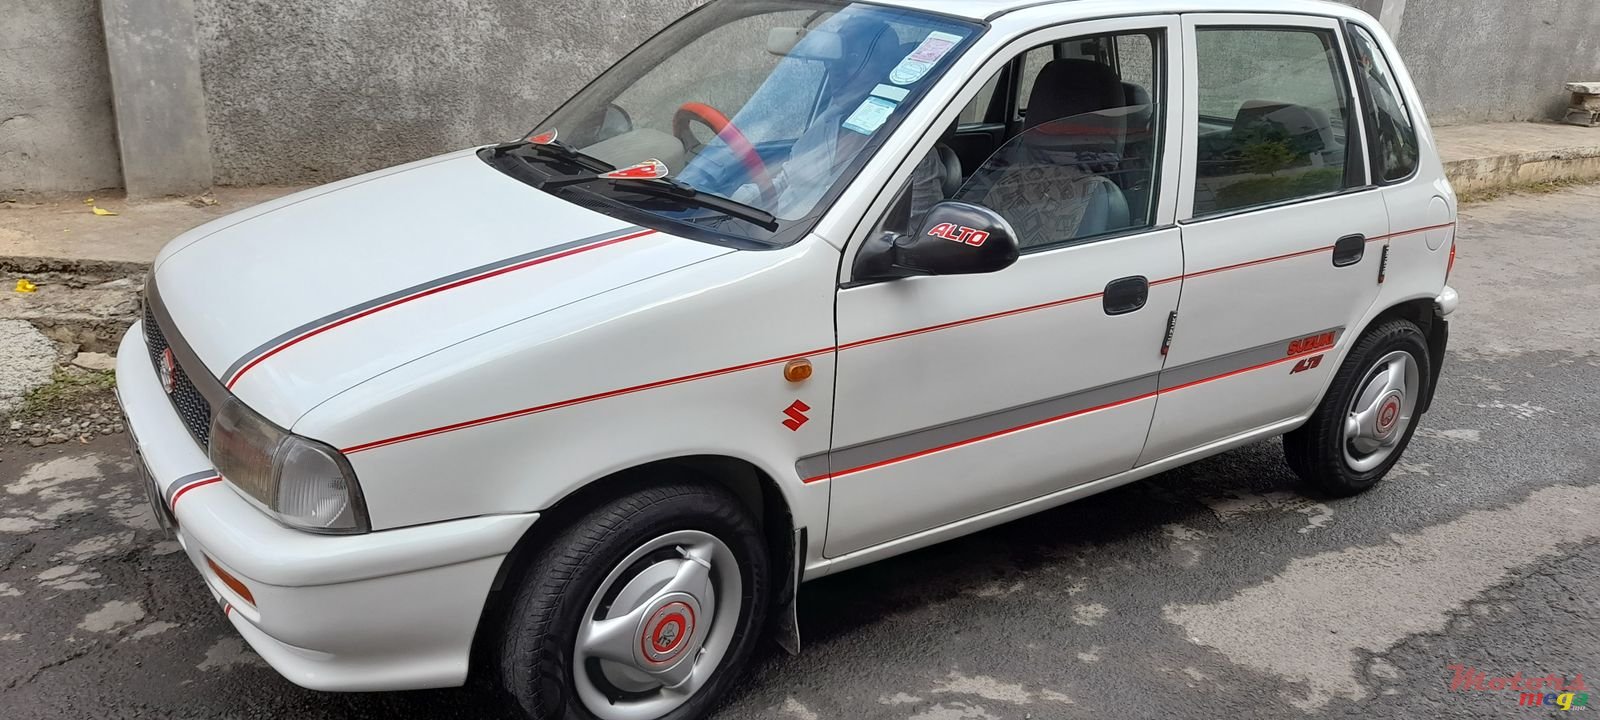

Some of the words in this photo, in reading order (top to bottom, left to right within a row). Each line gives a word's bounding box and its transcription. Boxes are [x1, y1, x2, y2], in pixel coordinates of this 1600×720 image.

[928, 222, 990, 247] ALTO
[1287, 331, 1336, 355] SUZUKI
[1289, 354, 1324, 375] ALTO
